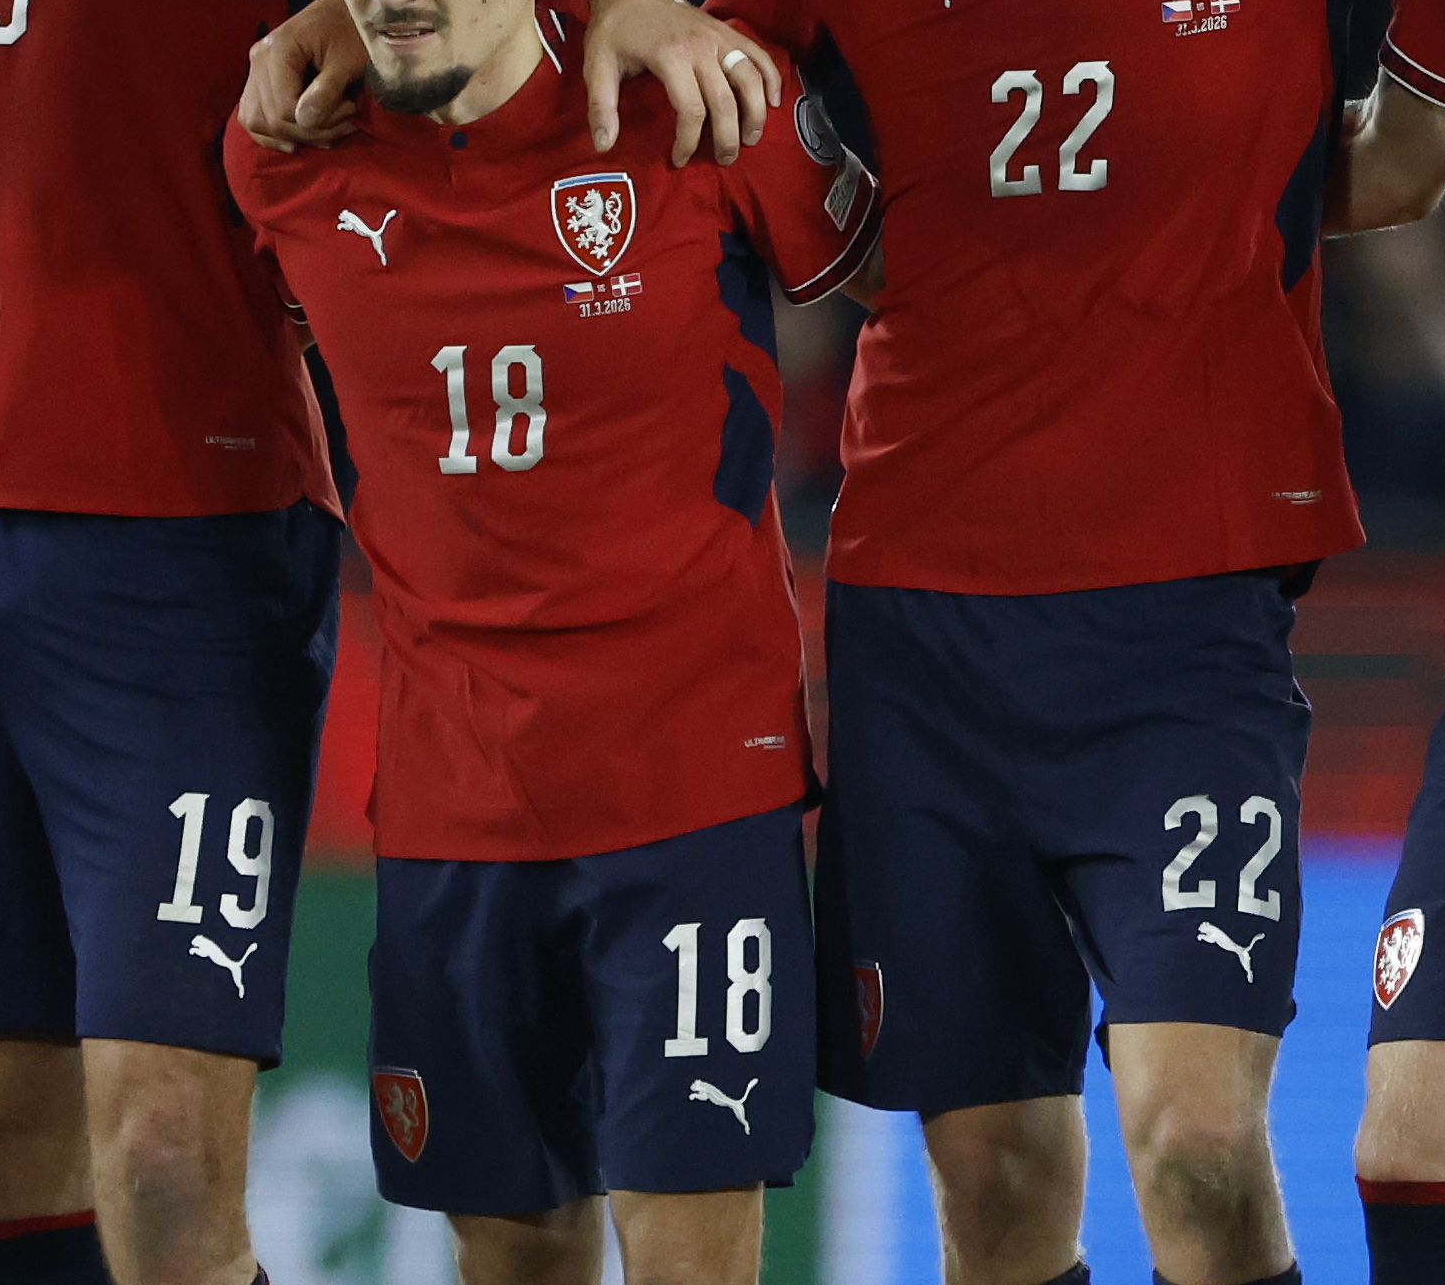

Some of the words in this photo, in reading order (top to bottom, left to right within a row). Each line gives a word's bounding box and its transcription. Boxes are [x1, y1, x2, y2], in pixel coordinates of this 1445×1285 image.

[990, 61, 1114, 193] 22
[579, 297, 631, 318] 31.3.2026
[431, 345, 547, 473] 18
[157, 793, 273, 929] 19
[1162, 795, 1281, 921] 22
[662, 918, 771, 1057] 18
